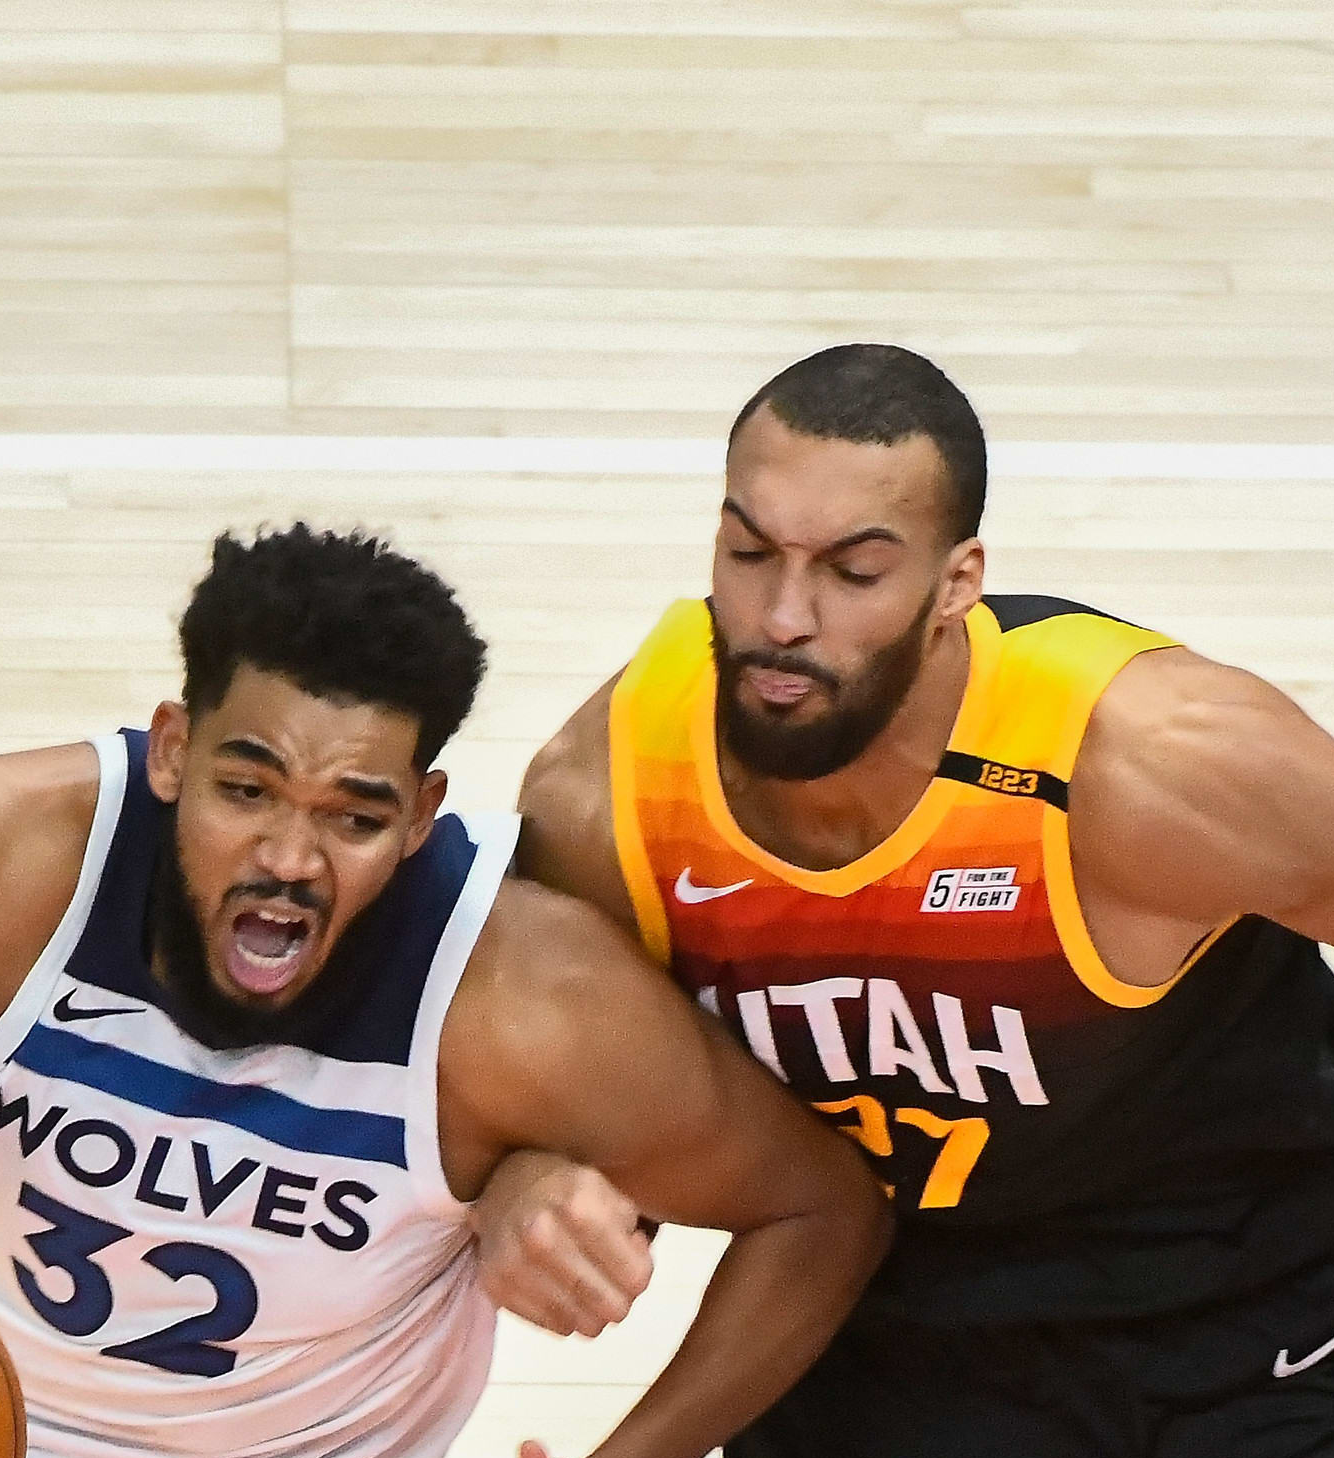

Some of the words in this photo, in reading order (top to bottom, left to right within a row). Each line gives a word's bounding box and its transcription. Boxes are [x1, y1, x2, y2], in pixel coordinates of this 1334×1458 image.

[977, 762, 1040, 794] 1223
[929, 873, 954, 908] 5
[958, 890, 1014, 907] FIGHT
[11, 1179, 259, 1378] 32
